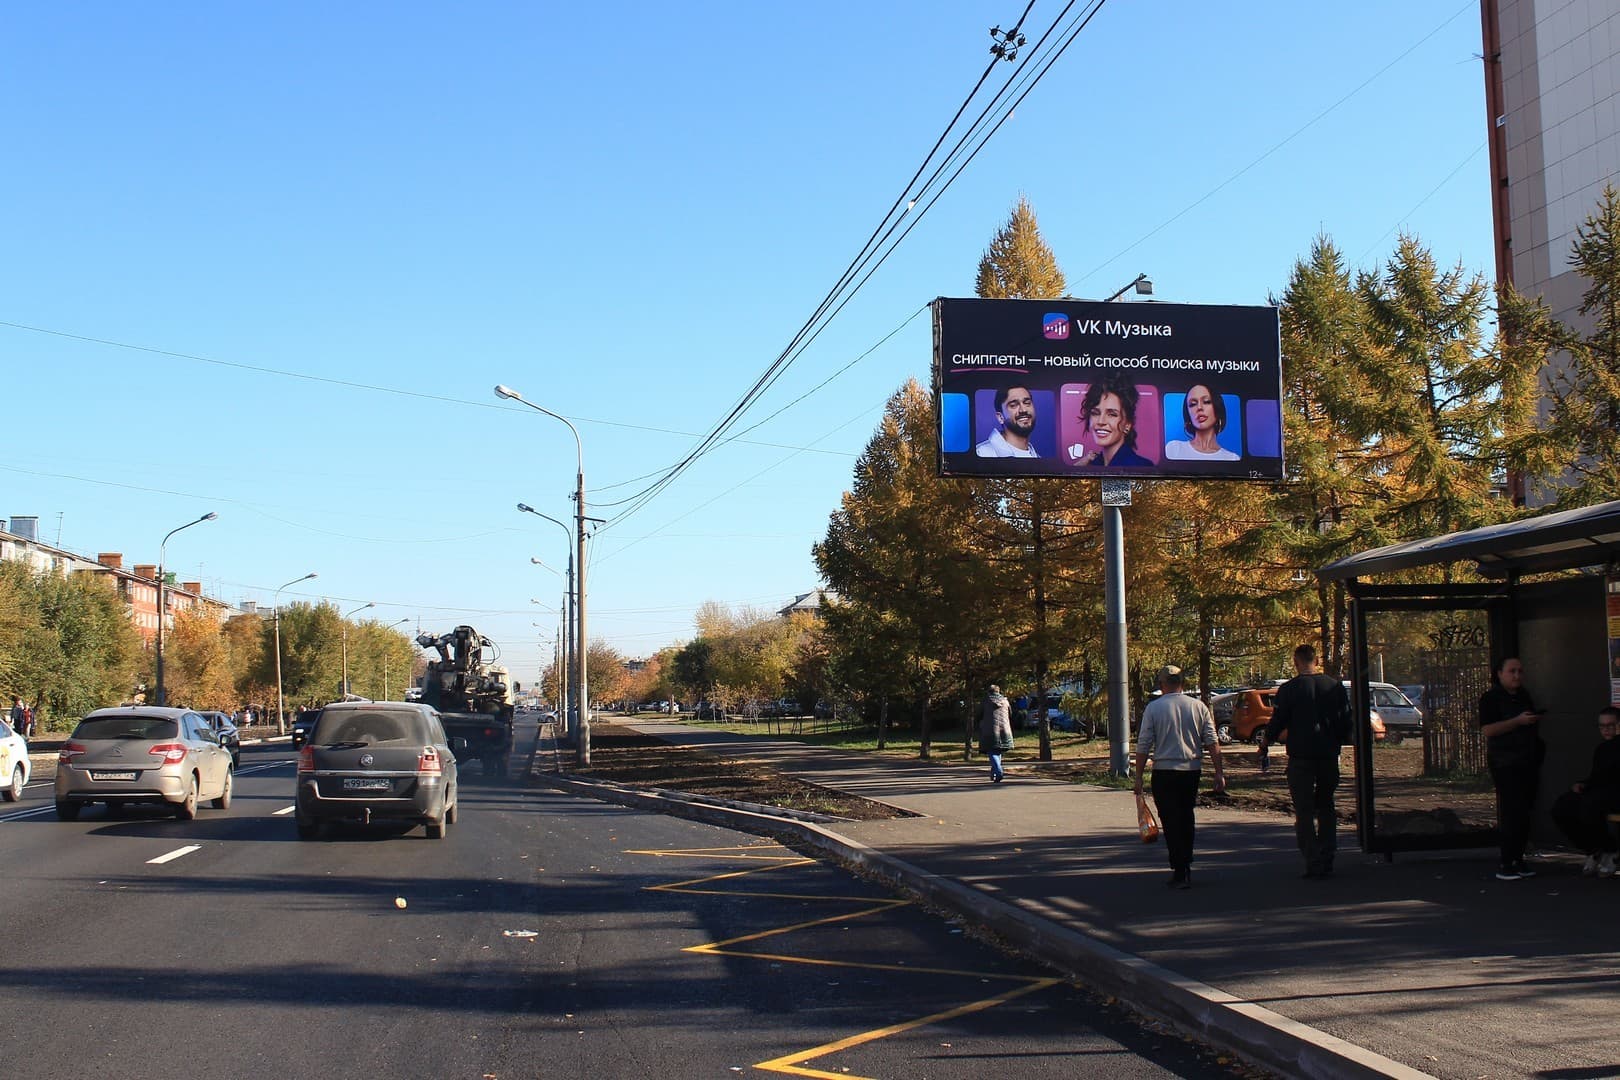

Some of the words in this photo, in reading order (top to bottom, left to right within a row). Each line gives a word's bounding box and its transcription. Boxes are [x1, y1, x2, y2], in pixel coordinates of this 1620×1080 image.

[1076, 319, 1101, 335] VK
[1105, 320, 1172, 339] Музыка
[952, 354, 1026, 366] сниппеты
[1044, 353, 1091, 367] новый
[1094, 355, 1149, 368] способ
[1152, 358, 1203, 370] поиска
[1206, 359, 1260, 374] музыки
[1248, 470, 1264, 479] 12+
